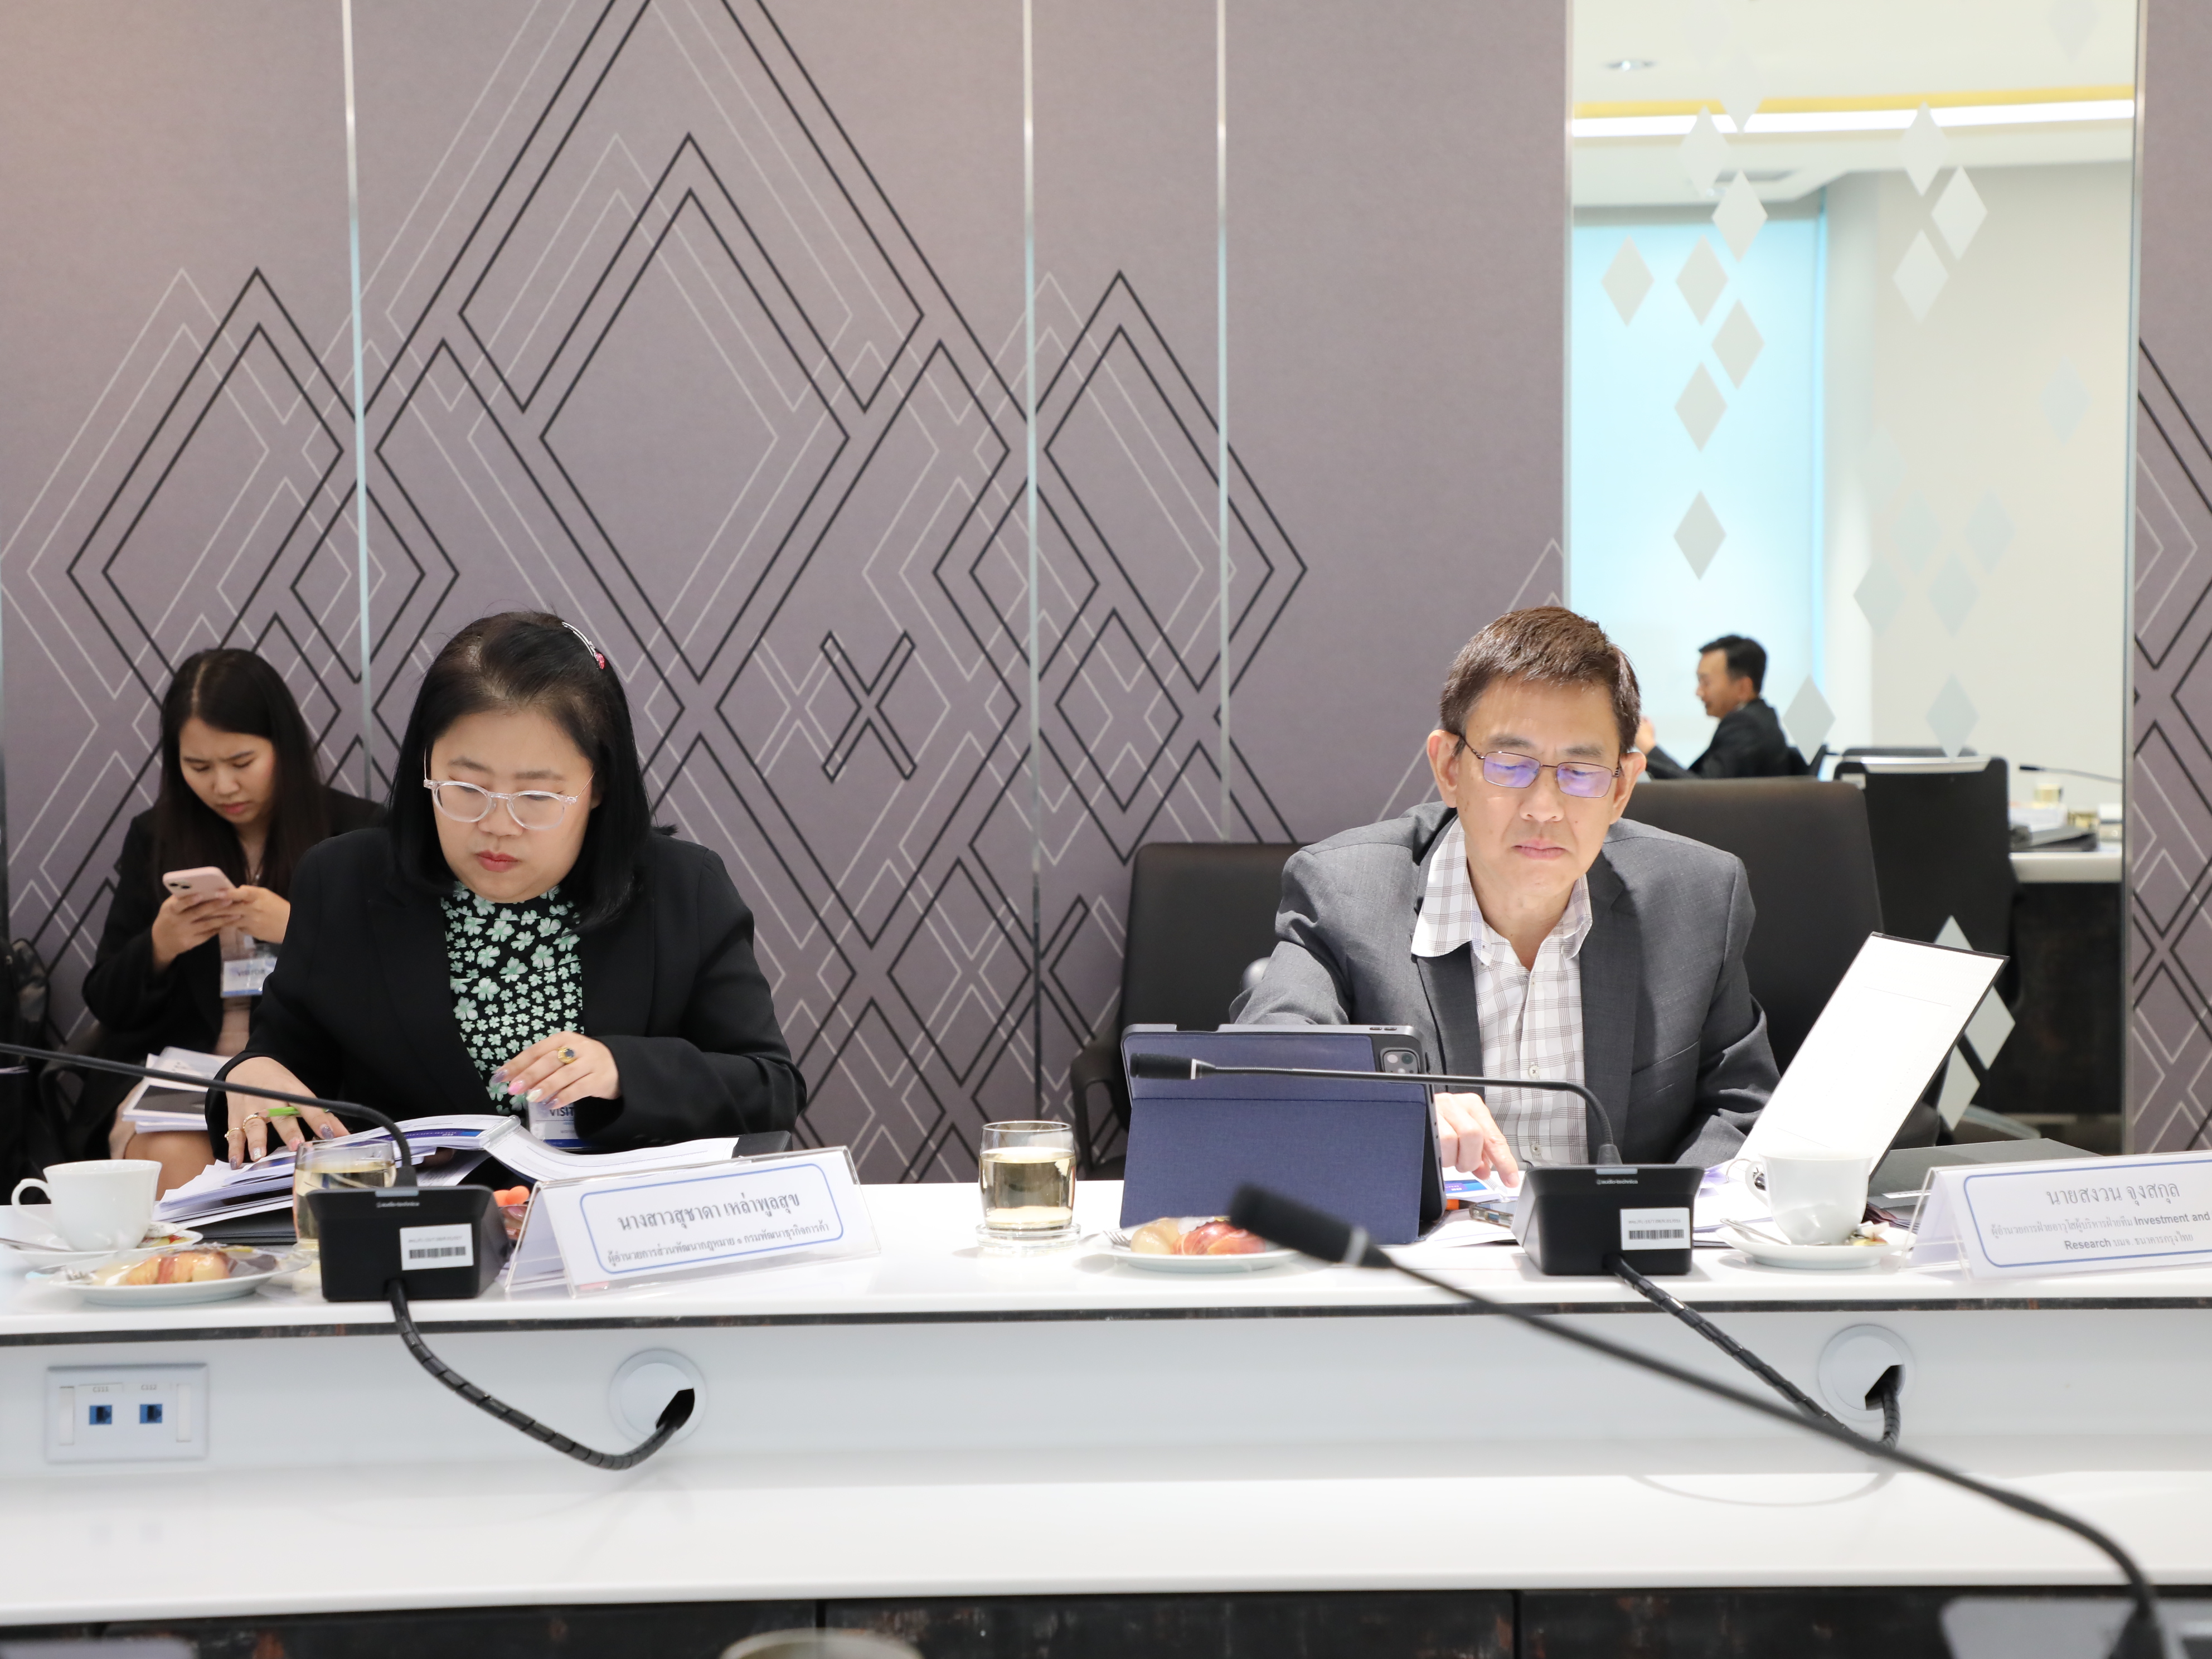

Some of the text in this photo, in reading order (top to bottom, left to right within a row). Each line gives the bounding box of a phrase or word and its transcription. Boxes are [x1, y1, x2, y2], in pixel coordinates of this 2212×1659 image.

[549, 1106, 574, 1116] VISIT
[2046, 1183, 2180, 1206] นายสงวน จุงสกุล
[617, 1192, 801, 1230] นางสาวสุชาดา เหล่าพูลสุข
[2134, 1212, 2190, 1226] Investment
[2192, 1211, 2210, 1221] and
[2064, 1238, 2112, 1250] Research
[2135, 1230, 2194, 1246] ธนาคารกรุงไทย
